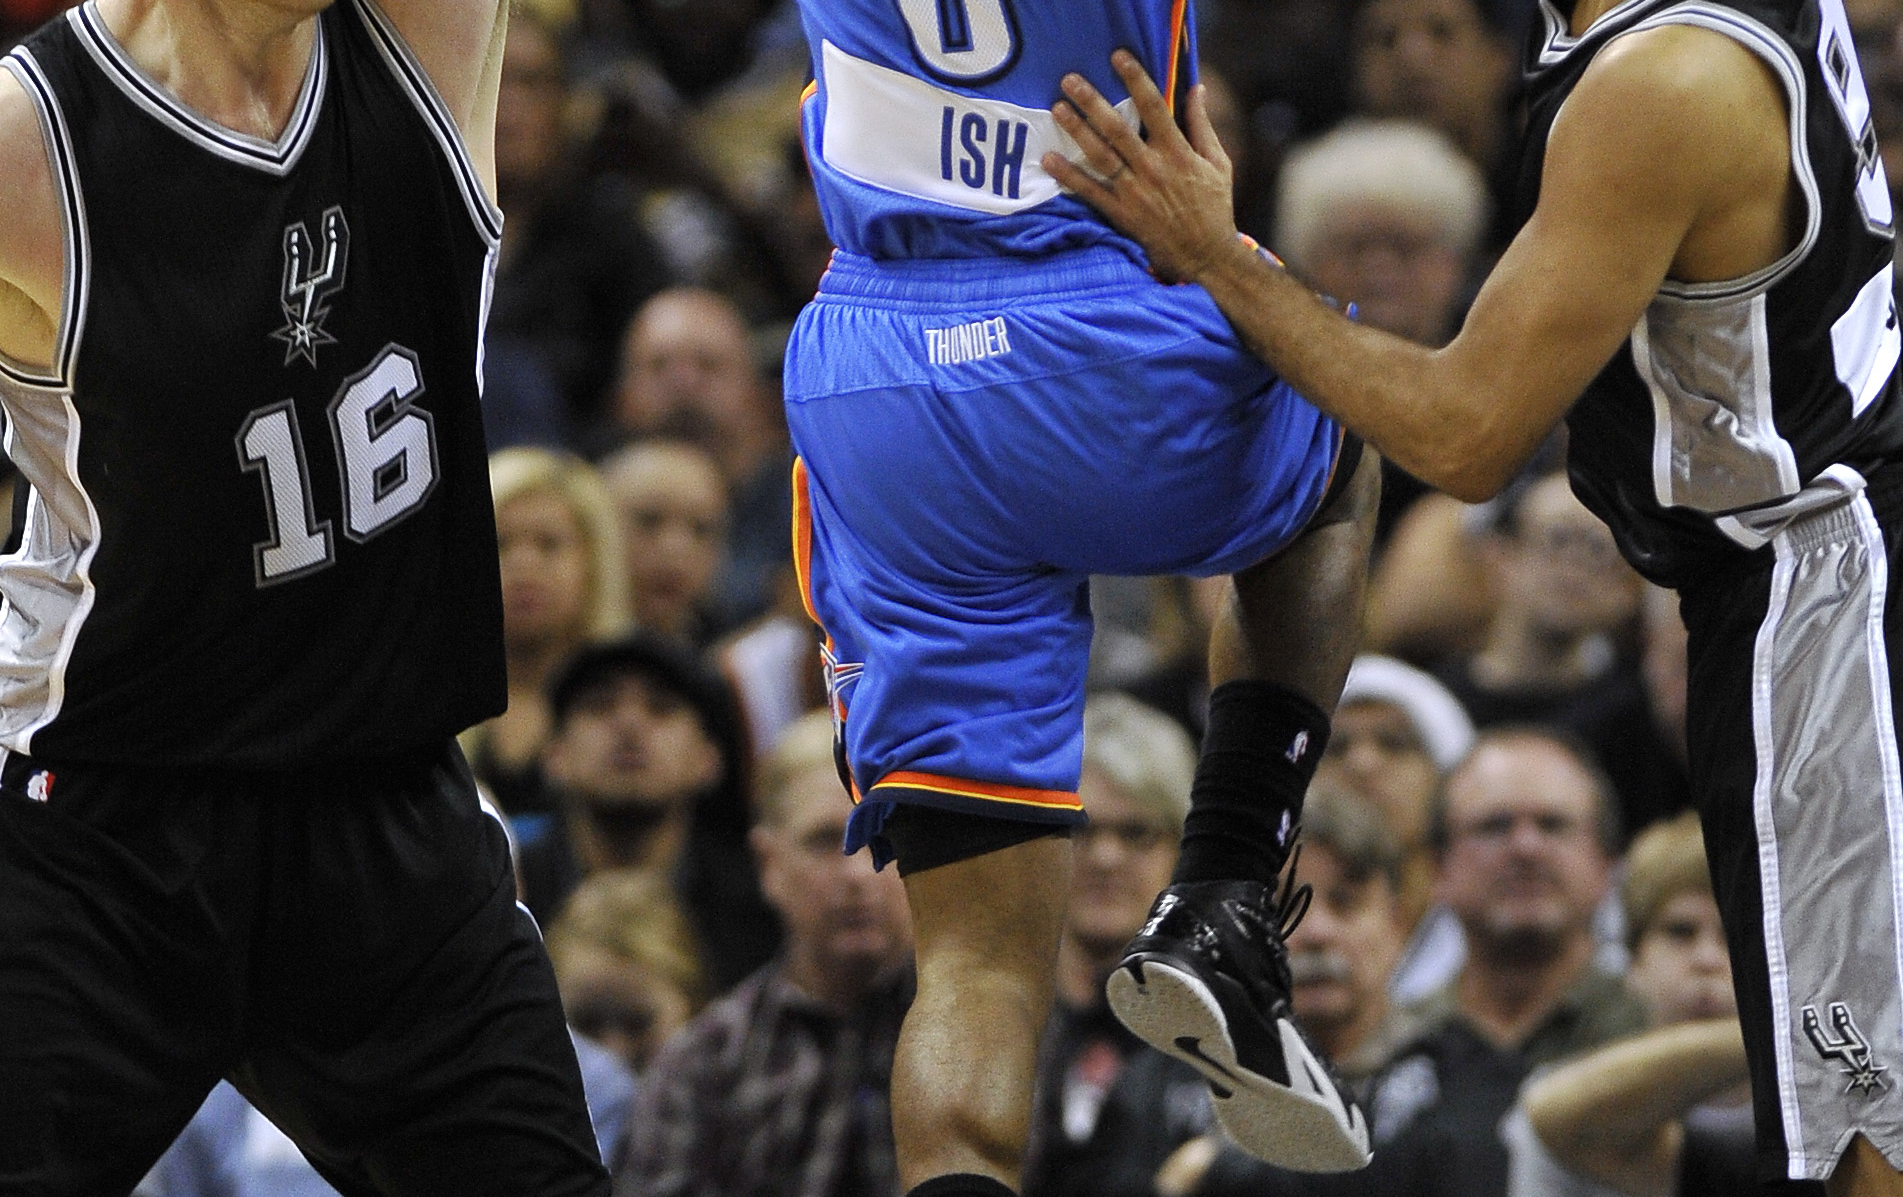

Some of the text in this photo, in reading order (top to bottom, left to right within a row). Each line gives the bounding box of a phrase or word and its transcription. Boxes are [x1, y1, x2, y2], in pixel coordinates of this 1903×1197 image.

[940, 105, 1028, 200] ISH
[924, 315, 1012, 365] THUNDER
[234, 341, 441, 589] 16
